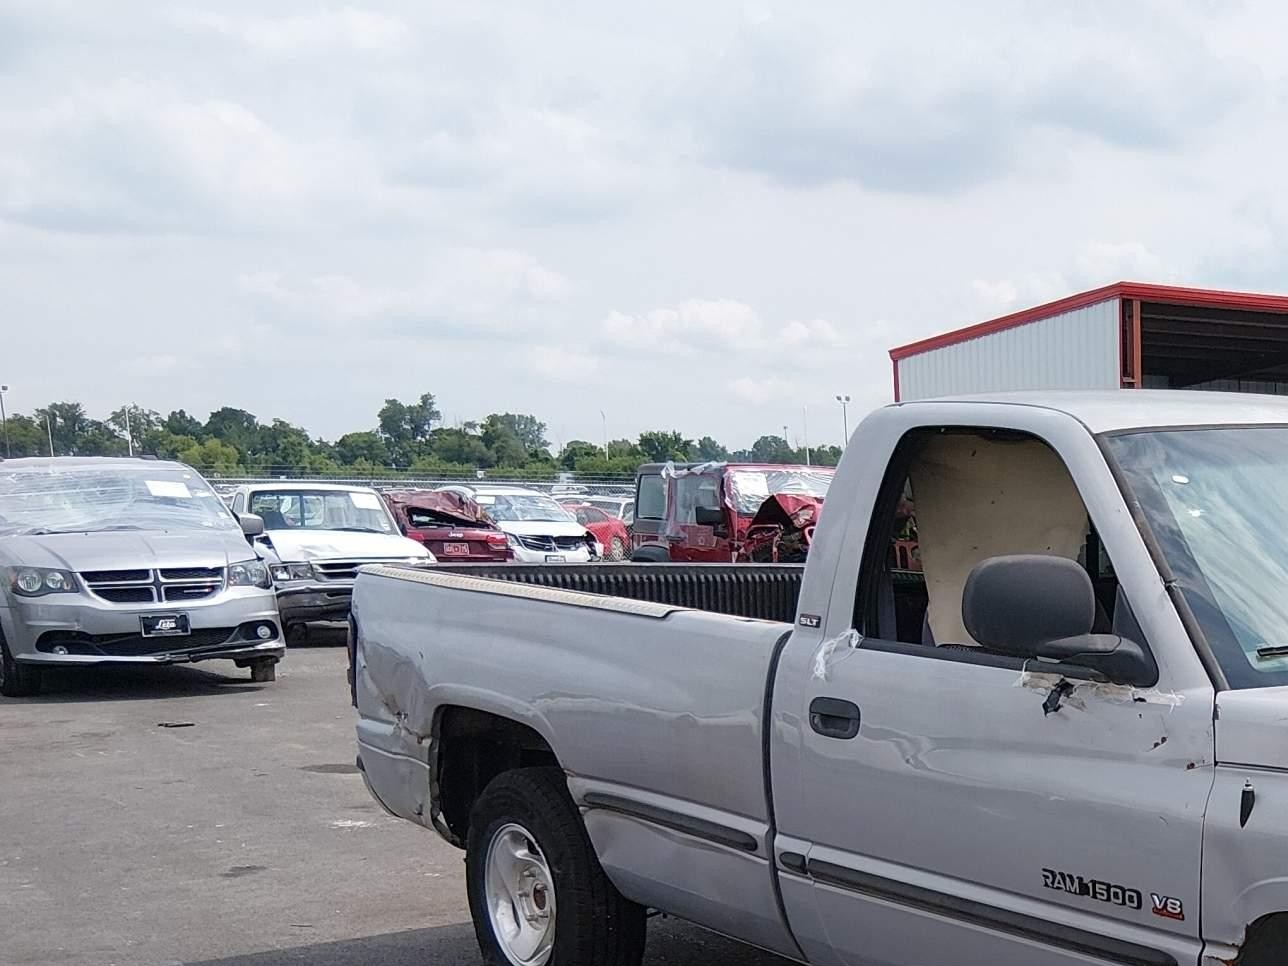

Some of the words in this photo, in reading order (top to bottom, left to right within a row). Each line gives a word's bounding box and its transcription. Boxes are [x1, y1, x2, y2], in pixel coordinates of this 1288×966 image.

[800, 616, 820, 626] SLT
[1042, 868, 1084, 895] RAM
[1087, 879, 1142, 910] 1500
[1151, 893, 1183, 914] V8
